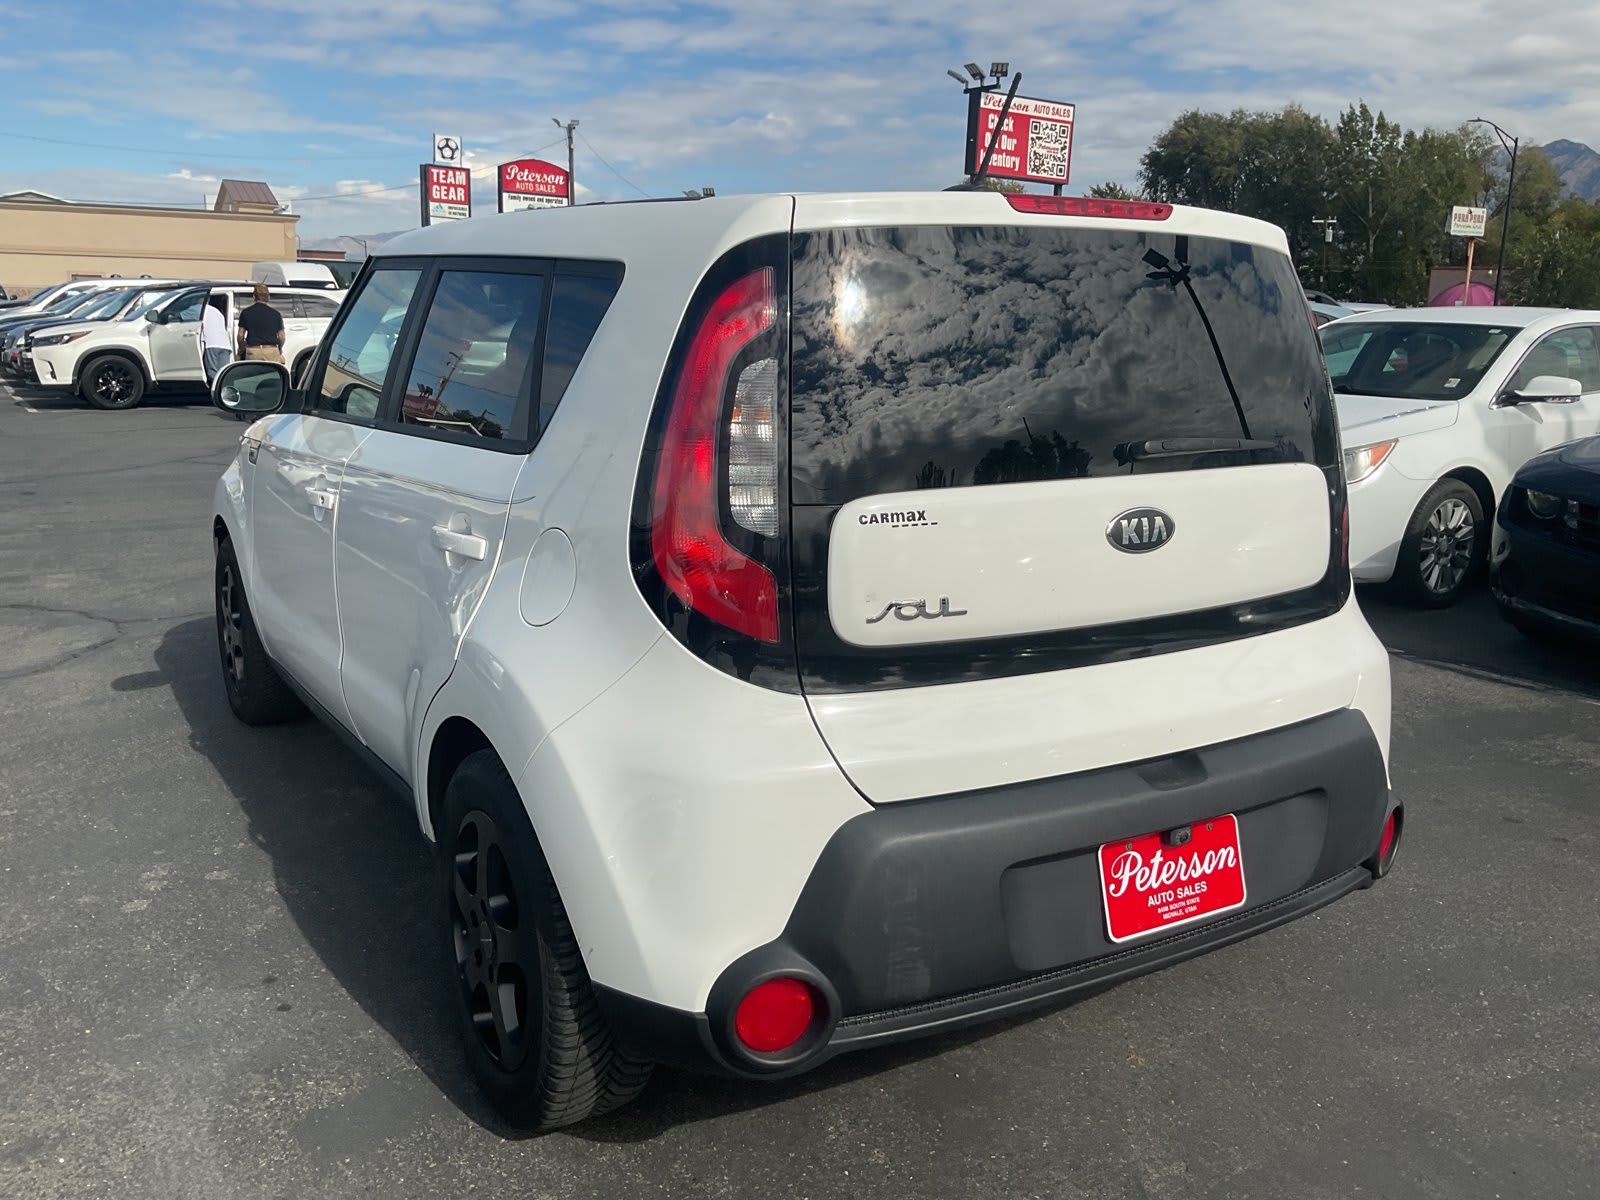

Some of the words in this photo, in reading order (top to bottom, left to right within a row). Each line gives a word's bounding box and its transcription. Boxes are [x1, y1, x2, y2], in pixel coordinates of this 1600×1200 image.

[984, 95, 1029, 112] Petson
[1033, 104, 1051, 115] AUTO
[1051, 106, 1071, 118] SALES
[988, 113, 1014, 132] Chck
[1001, 134, 1017, 151] Our
[431, 169, 466, 185] TEAM
[506, 165, 565, 185] Peterson
[432, 185, 465, 201] GEAR
[516, 182, 534, 191] AUTO
[535, 183, 556, 193] SALES
[1120, 516, 1168, 545] KIA
[866, 597, 968, 624] SOUL
[1109, 846, 1237, 897] Peterson
[1147, 890, 1175, 907] AUTO
[1177, 881, 1208, 899] SALES
[1169, 901, 1186, 910] SOUTH
[1186, 896, 1200, 906] STATE
[1185, 904, 1198, 913] UTAH
